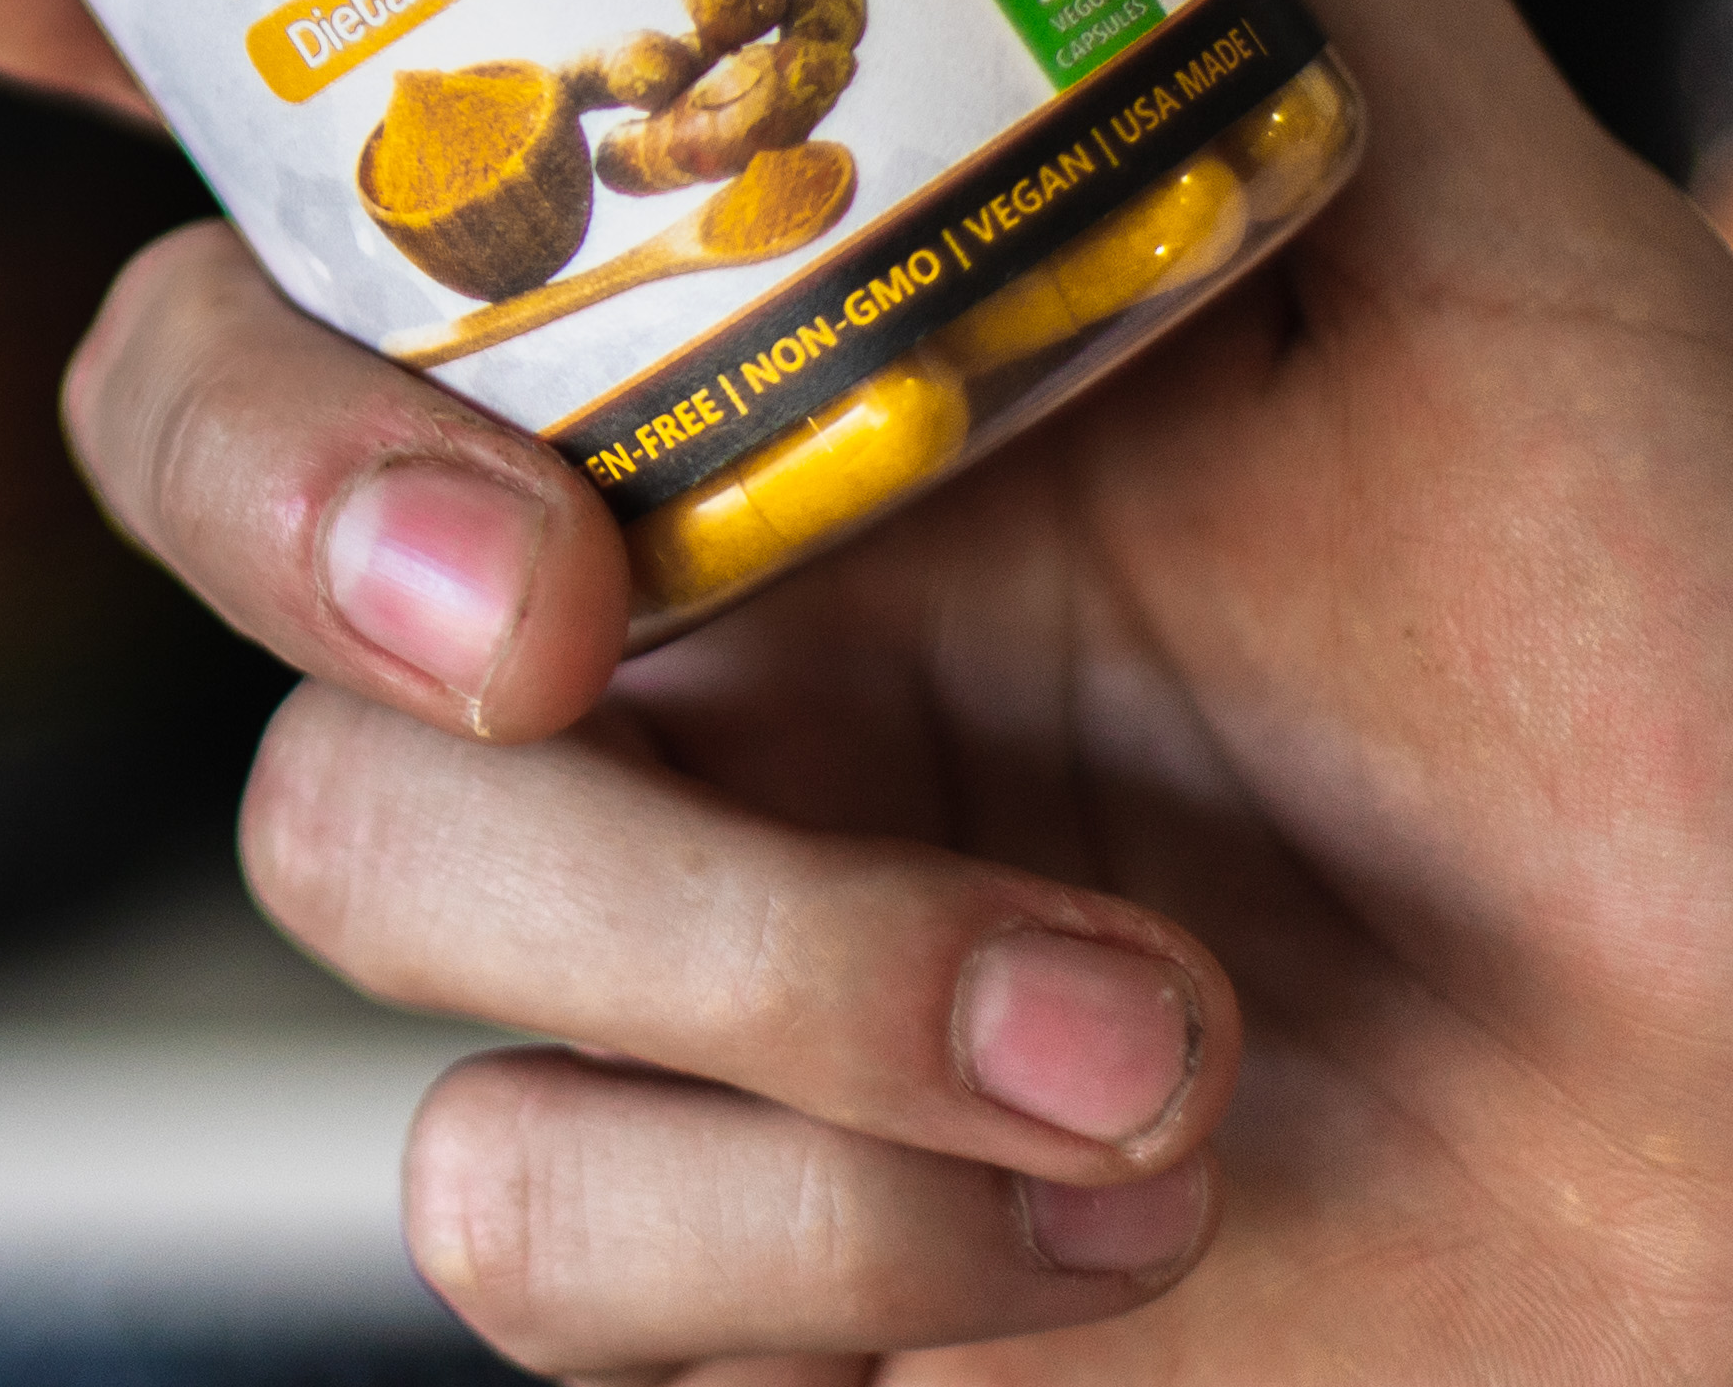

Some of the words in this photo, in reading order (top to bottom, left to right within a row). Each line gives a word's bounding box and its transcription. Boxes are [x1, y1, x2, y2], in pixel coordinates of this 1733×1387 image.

[739, 248, 942, 395] NON-GMO
[962, 142, 1096, 244] VEGAN
[1110, 85, 1183, 143] USA
[1173, 28, 1255, 100] MADE
